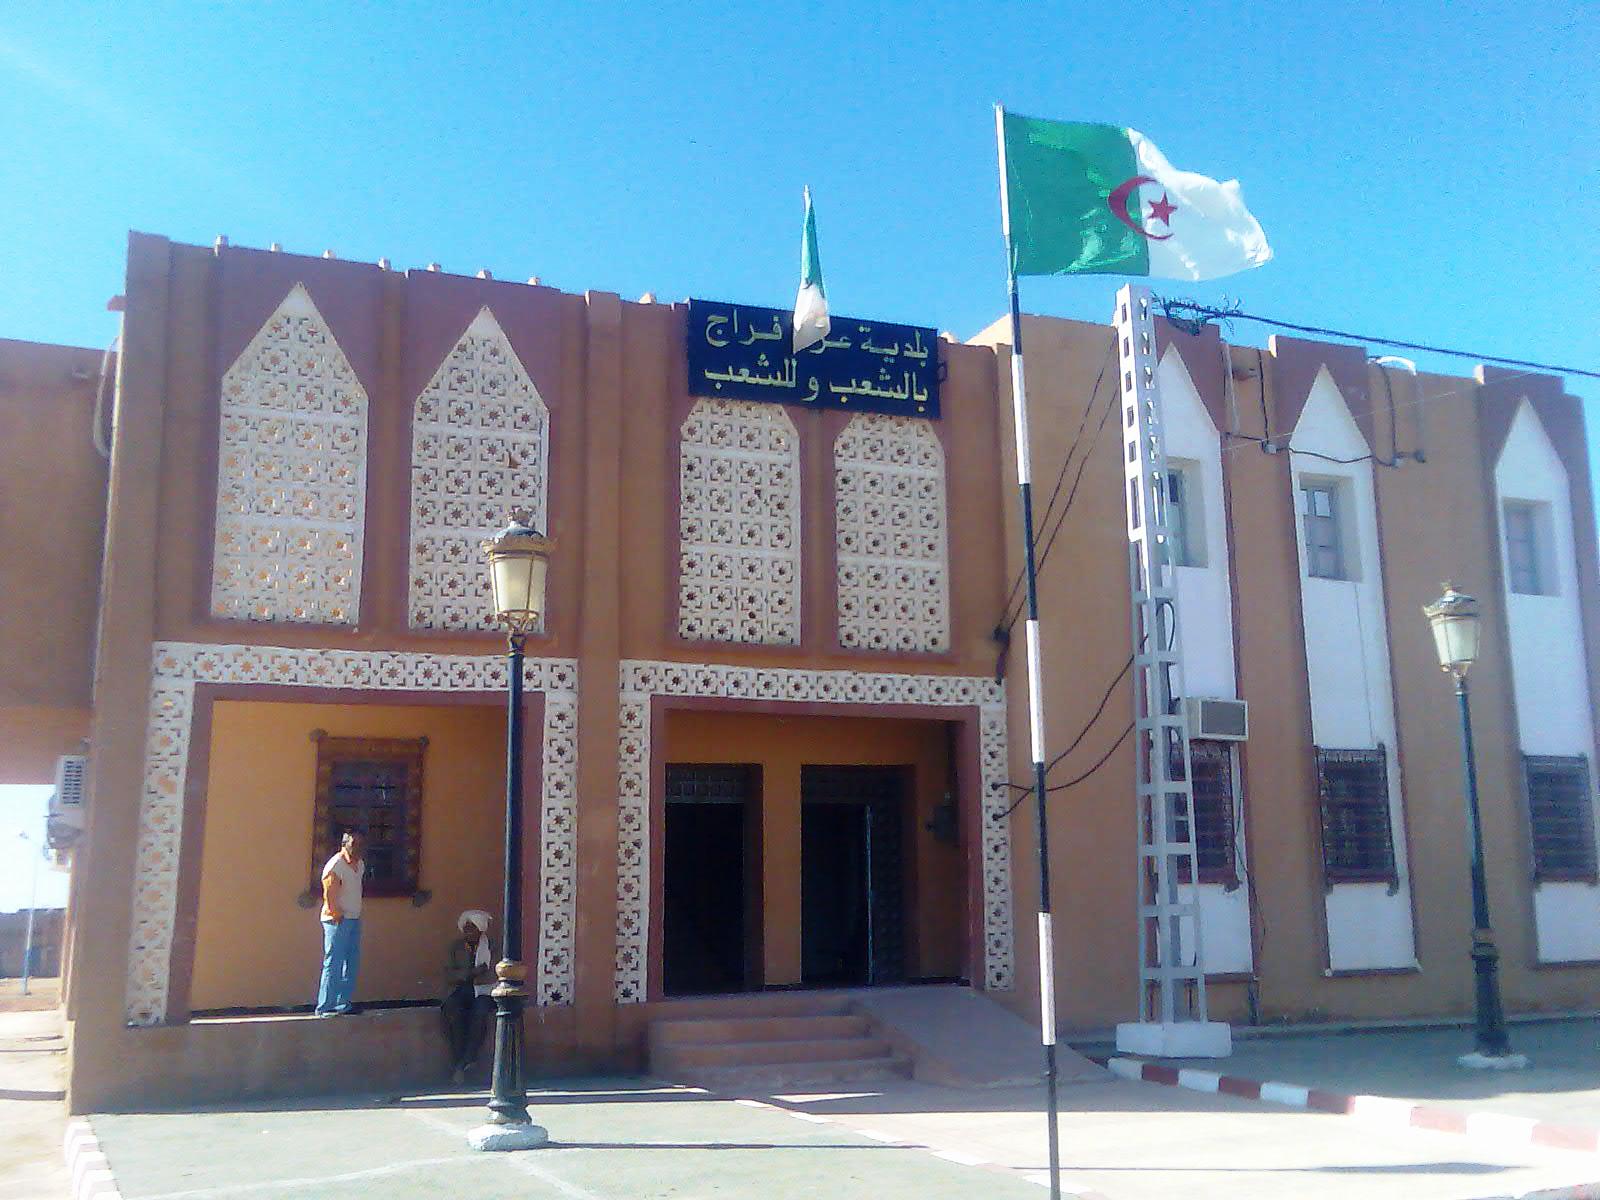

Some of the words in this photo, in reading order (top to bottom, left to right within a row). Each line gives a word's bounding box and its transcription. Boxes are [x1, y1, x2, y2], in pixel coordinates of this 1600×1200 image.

[705, 308, 783, 348] فراج
[858, 325, 929, 368] بلدية
[704, 353, 798, 390] للشعب
[800, 375, 820, 402] و
[828, 367, 929, 412] بالشعب
